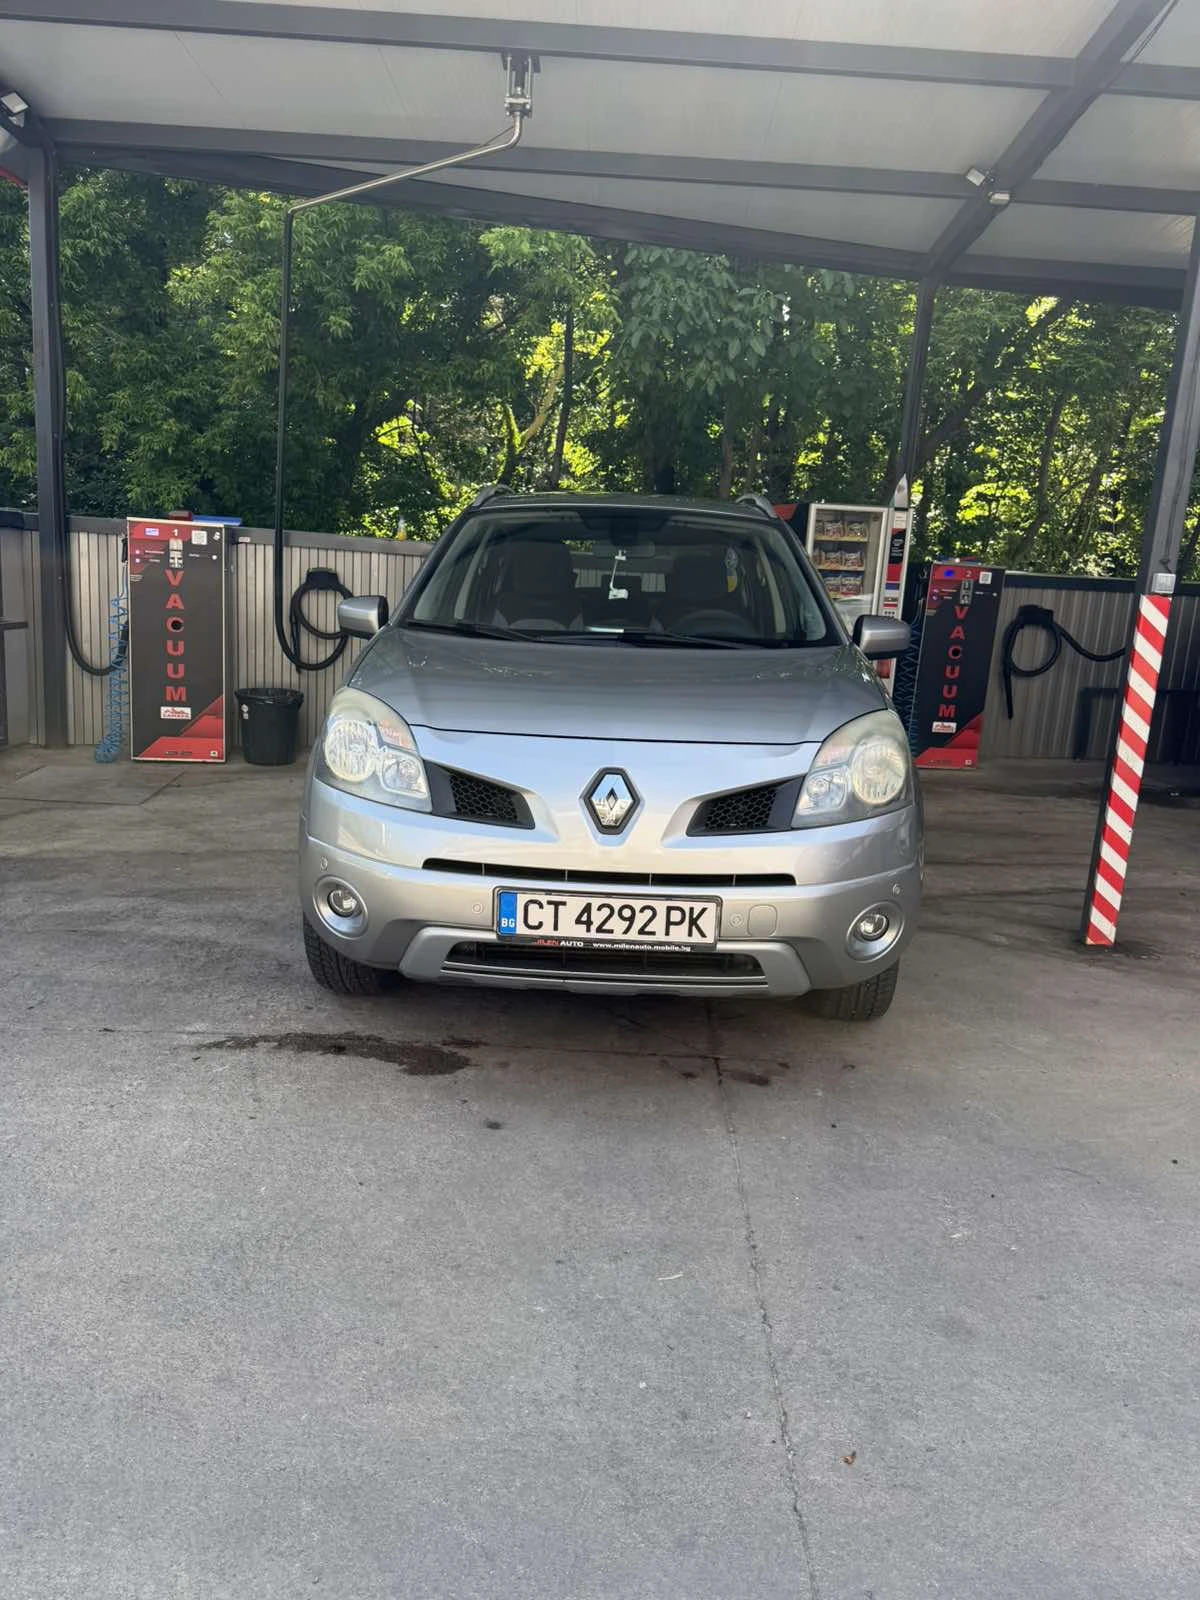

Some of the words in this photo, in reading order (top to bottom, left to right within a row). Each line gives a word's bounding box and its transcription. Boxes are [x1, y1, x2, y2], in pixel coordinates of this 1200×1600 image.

[165, 569, 187, 702] VACUUM
[938, 605, 969, 718] VACUUM
[501, 917, 516, 928] BG
[523, 898, 567, 932] CT
[575, 902, 658, 936] 4292
[665, 905, 708, 939] PK
[560, 940, 584, 948] AUTO
[592, 942, 691, 953] www.milenauto.mobile.bg
